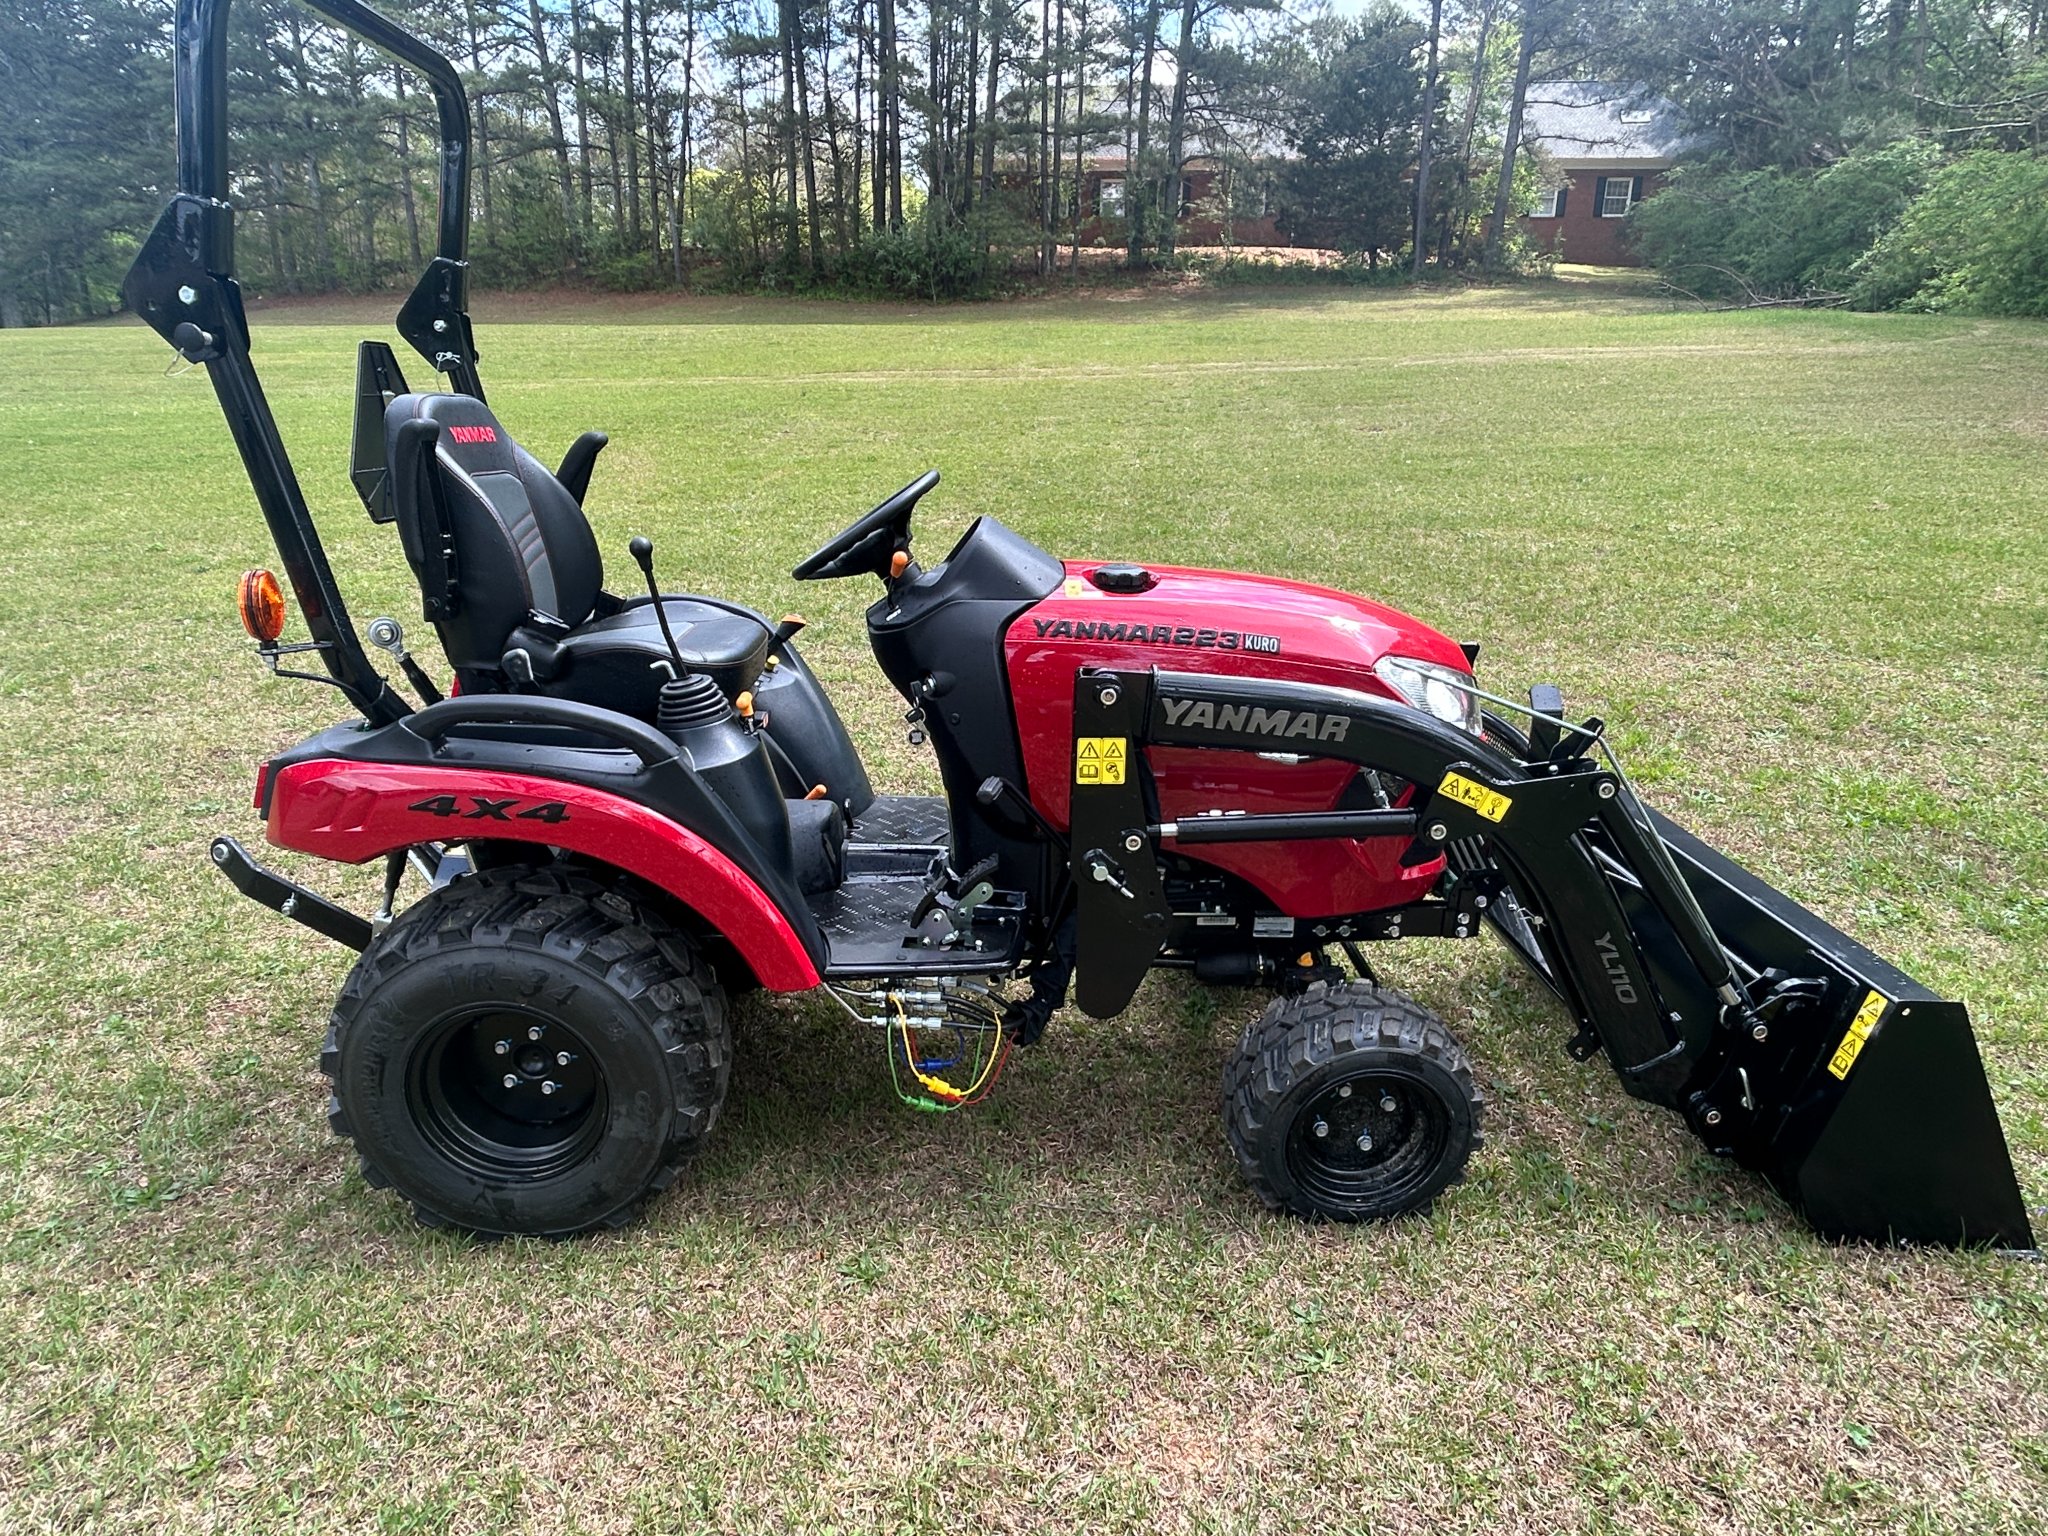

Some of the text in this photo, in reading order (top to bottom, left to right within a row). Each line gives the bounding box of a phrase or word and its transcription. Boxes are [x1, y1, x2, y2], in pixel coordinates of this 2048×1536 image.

[449, 426, 496, 443] YANMAR
[1244, 634, 1279, 653] KURO
[1161, 697, 1350, 742] YANMAR
[408, 794, 571, 824] 4X4
[1594, 931, 1638, 1003] YL110
